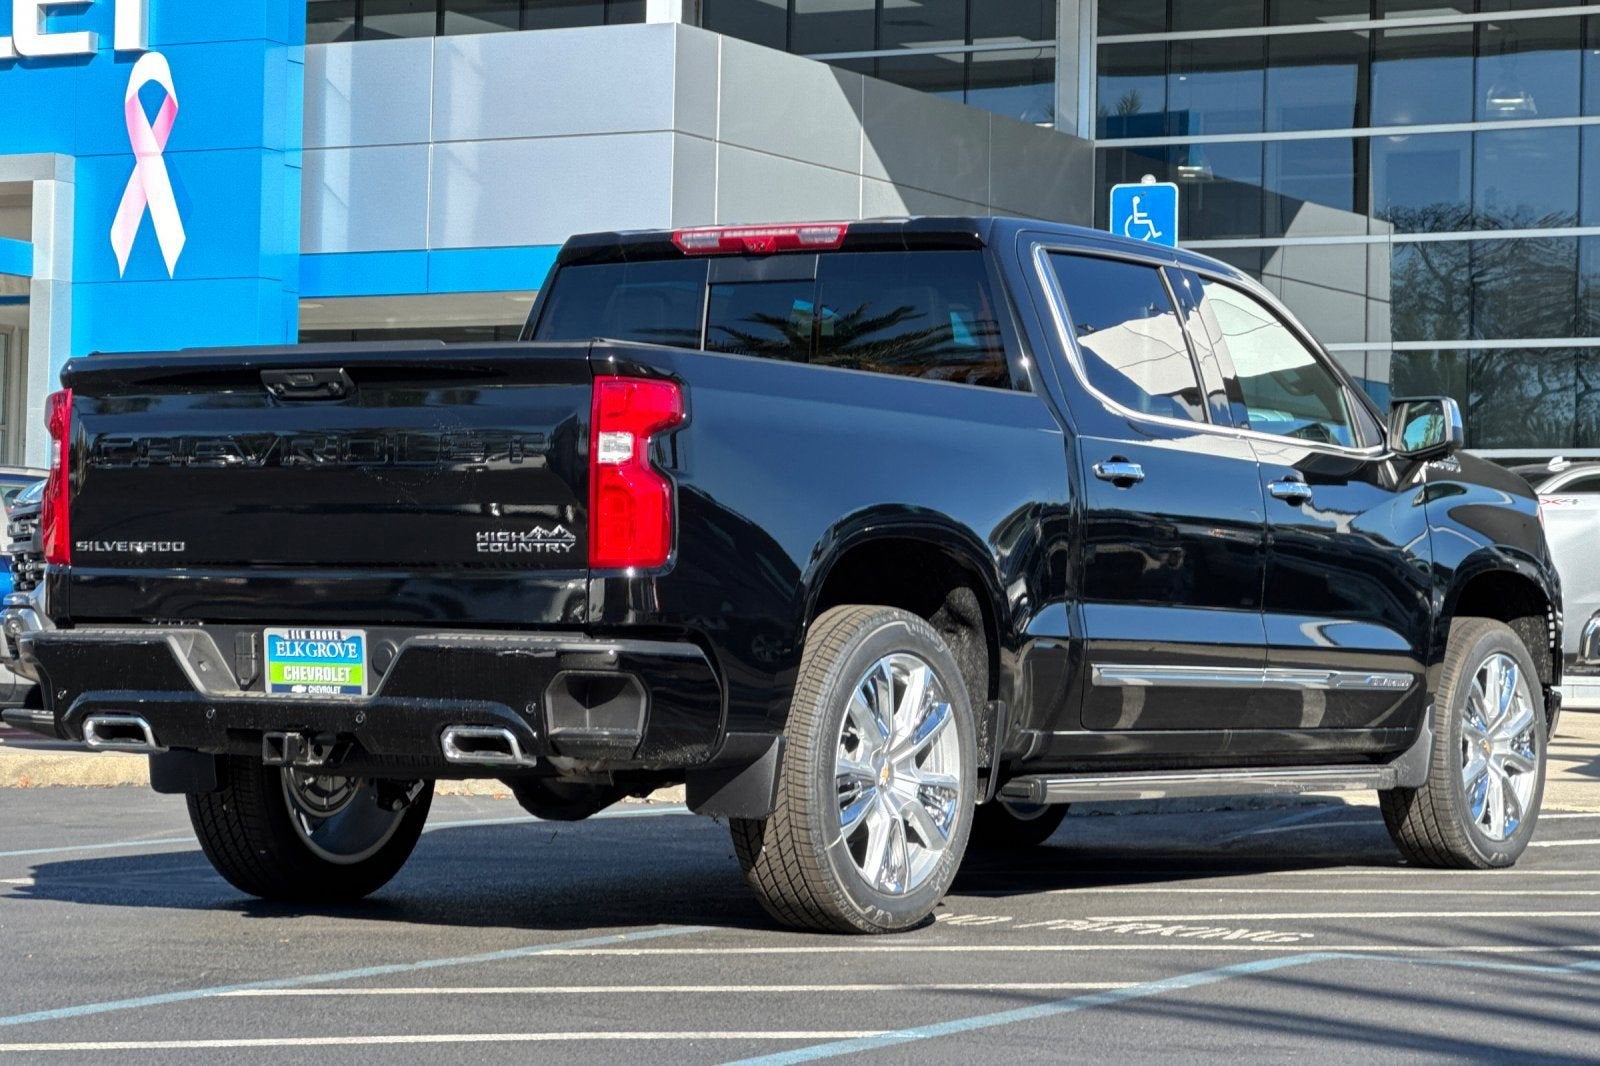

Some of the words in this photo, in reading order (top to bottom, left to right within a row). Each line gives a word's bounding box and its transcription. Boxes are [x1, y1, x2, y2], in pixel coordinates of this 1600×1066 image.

[91, 433, 548, 469] CHEVROLET
[476, 531, 526, 542] HIGH
[75, 540, 185, 553] SILVERADO
[476, 542, 576, 554] COUNTRY
[290, 629, 307, 640] ELK
[309, 630, 339, 641] GROVE
[283, 665, 351, 682] CHEVROLET
[307, 685, 341, 694] CHEVROLET
[1012, 918, 1315, 943] PARKING
